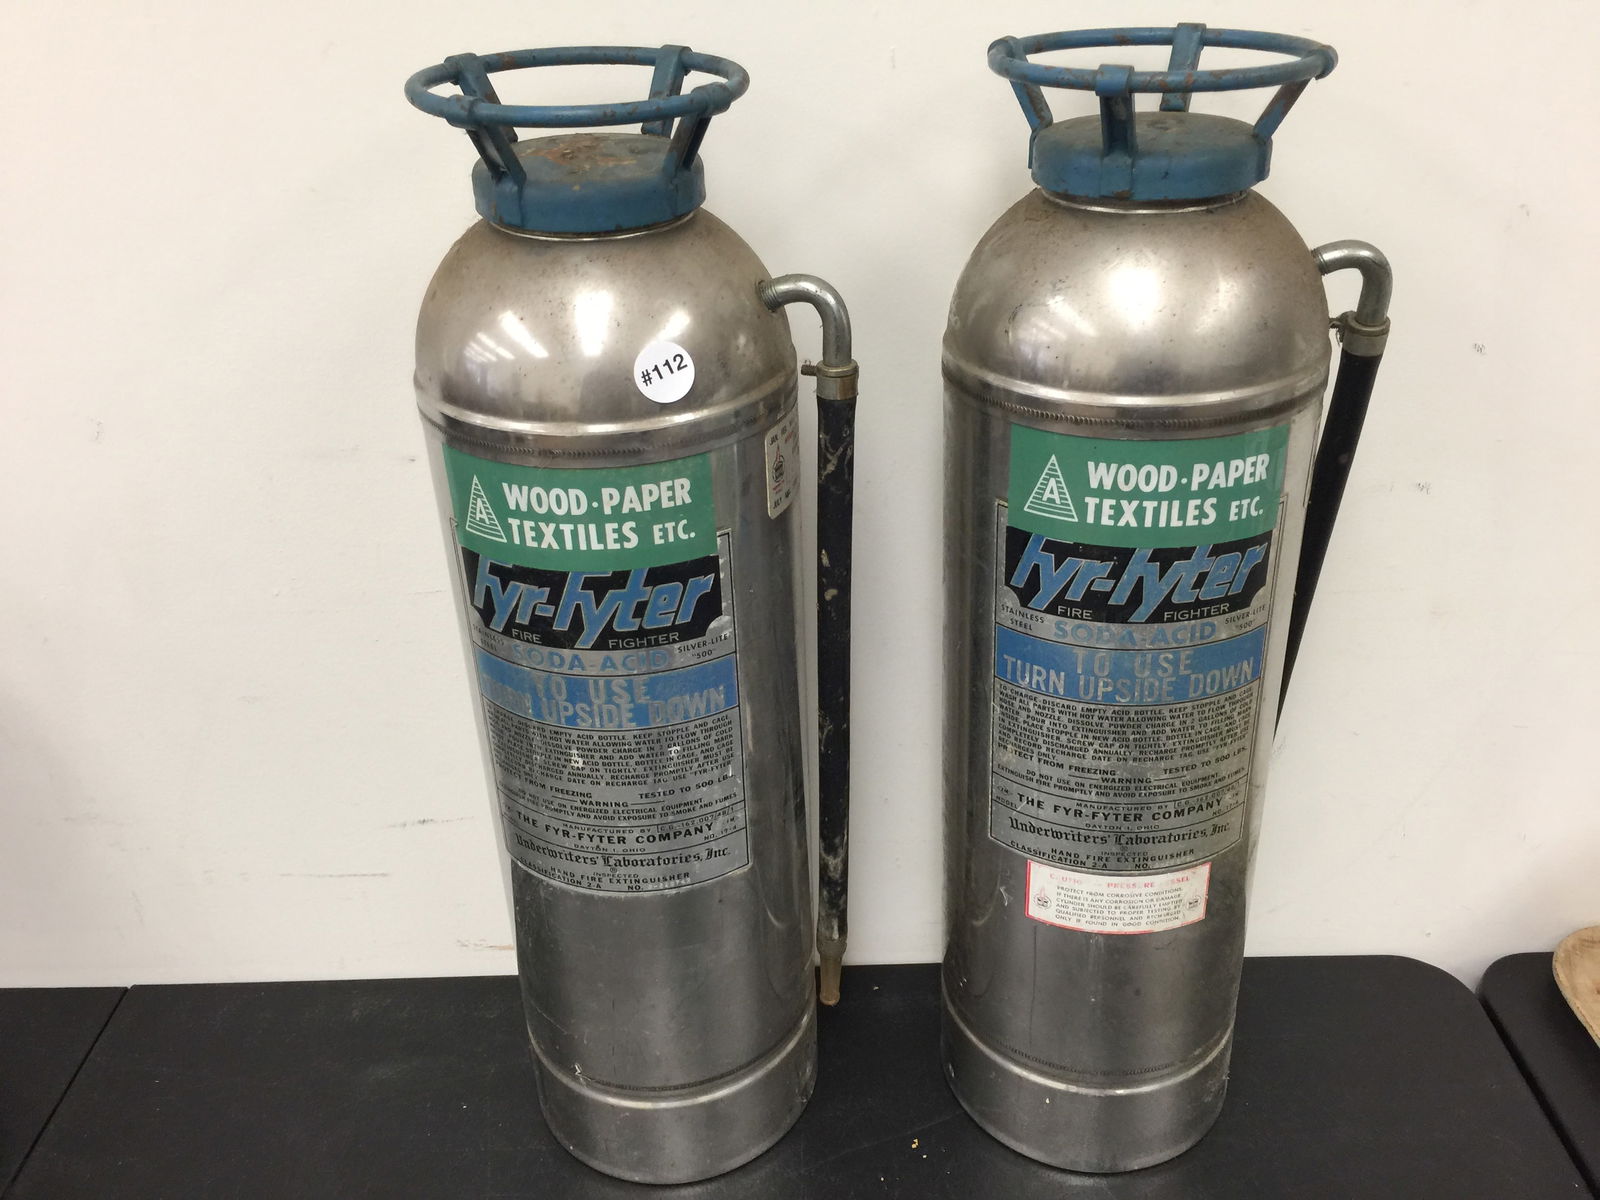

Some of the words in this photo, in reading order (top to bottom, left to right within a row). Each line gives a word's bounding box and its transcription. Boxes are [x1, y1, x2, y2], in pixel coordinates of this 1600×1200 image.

[641, 353, 687, 386] #112
[1087, 461, 1178, 492] WOOD
[1191, 453, 1270, 491] PAPER
[502, 482, 588, 517] WOOD
[602, 477, 692, 515] PAPER
[1042, 477, 1060, 505] A
[476, 498, 490, 524] A
[1084, 496, 1217, 527] TEXTILES
[1229, 495, 1263, 522] ETC.
[507, 518, 639, 550] TEXTILES
[652, 519, 695, 545] ETC.
[1001, 604, 1044, 623] STAINLESS
[1057, 605, 1093, 619] FIRE
[1164, 602, 1230, 621] FIGHTER
[1010, 618, 1033, 631] STEEL
[512, 629, 542, 644] FIRE
[608, 631, 680, 649] FIGHTER
[678, 633, 728, 653] SILVER-LITE
[1072, 647, 1111, 677] TO
[1134, 650, 1194, 678] USE
[1003, 654, 1065, 696] TURN
[1079, 675, 1176, 703] UPSIDE
[1189, 656, 1254, 697] DOWN
[589, 676, 650, 704] USE
[541, 698, 636, 728] UPSIDE
[648, 685, 725, 724] DOWN
[1033, 703, 1056, 713] PARTS
[1169, 712, 1194, 720] WATER
[1042, 699, 1077, 711] DISCARD
[1081, 707, 1107, 715] EMPTY
[1191, 699, 1220, 710] STOPPLE
[1026, 714, 1046, 724] POUR
[1072, 725, 1127, 736] EXTINGUISHER
[1170, 726, 1195, 734] WATER
[1068, 717, 1104, 728] DISSOLVE
[1198, 711, 1227, 722] GALLONS
[550, 730, 572, 739] EMPTY
[657, 726, 689, 737] STOPPLE
[565, 738, 590, 746] WATER
[592, 739, 632, 747] ALLOWING
[635, 738, 660, 746] WATER
[676, 732, 697, 741] FLOW
[700, 720, 732, 734] THROUGH
[667, 737, 700, 748] GALLONS
[715, 727, 733, 737] COLD
[1046, 727, 1078, 738] STOPPLE
[1067, 738, 1095, 747] SCREW
[1172, 731, 1223, 747] EXTINGUISHER
[545, 747, 595, 760] EXTINGUISHER
[639, 751, 665, 760] WATER
[683, 742, 711, 753] FILLING
[714, 733, 733, 744] MARK
[582, 759, 600, 767] ACID
[717, 740, 733, 750] CAGE
[1042, 740, 1089, 753] DISCHARGED
[1139, 748, 1177, 756] RECHARGE
[1181, 740, 1217, 752] PROMPTLY
[1046, 747, 1088, 760] RECHARGE
[1132, 755, 1174, 763] RECHARGE
[644, 758, 700, 772] EXTINGUISHER
[703, 752, 722, 760] MUST
[654, 766, 693, 778] PROMPTLY
[697, 759, 719, 769] AFTER
[722, 753, 734, 761] USE
[1038, 758, 1064, 769] FROM
[1068, 765, 1116, 776] FREEZING
[1163, 764, 1197, 774] TESTED
[550, 786, 592, 799] FREEZING
[638, 789, 675, 799] TESTED
[696, 780, 713, 789] 500
[1054, 784, 1093, 796] PROMPTLY
[1138, 789, 1175, 798] EXPOSURE
[1190, 782, 1212, 792] SMOKE
[1089, 783, 1131, 791] ENERGIZED
[1134, 782, 1177, 791] ELECTRICAL
[570, 805, 609, 814] ENERGIZED
[618, 813, 656, 821] EXPOSURE
[671, 807, 696, 816] SMOKE
[715, 792, 737, 805] FUMES
[1017, 792, 1045, 809] THE
[1053, 804, 1143, 822] FYR-FYTER
[1151, 798, 1223, 820] COMPANY
[1075, 802, 1152, 811] MANUFACTURED
[516, 811, 538, 828] THE
[545, 824, 627, 844] FYR-FYTER
[635, 822, 713, 844] COMPANY
[562, 823, 634, 834] MANUFACTURED
[1085, 823, 1122, 831] DAYTON
[574, 843, 608, 852] DAYTON
[1010, 840, 1087, 866] CLASSIFICATION
[1051, 848, 1080, 859] HAND
[1086, 854, 1111, 863] FIRE
[1117, 848, 1195, 863] EXTINGUISHER
[581, 874, 603, 882] FIRE
[609, 872, 690, 884] EXTINGUISHER
[1107, 881, 1154, 889] PRESSRE
[1057, 885, 1084, 895] PROTECT
[1156, 893, 1181, 902] DAMAGE
[1056, 898, 1085, 907] CYLINDER
[1072, 906, 1104, 914] SUBJECTED
[1055, 908, 1087, 918] QUALIFIED
[1055, 914, 1072, 922] ONLY
